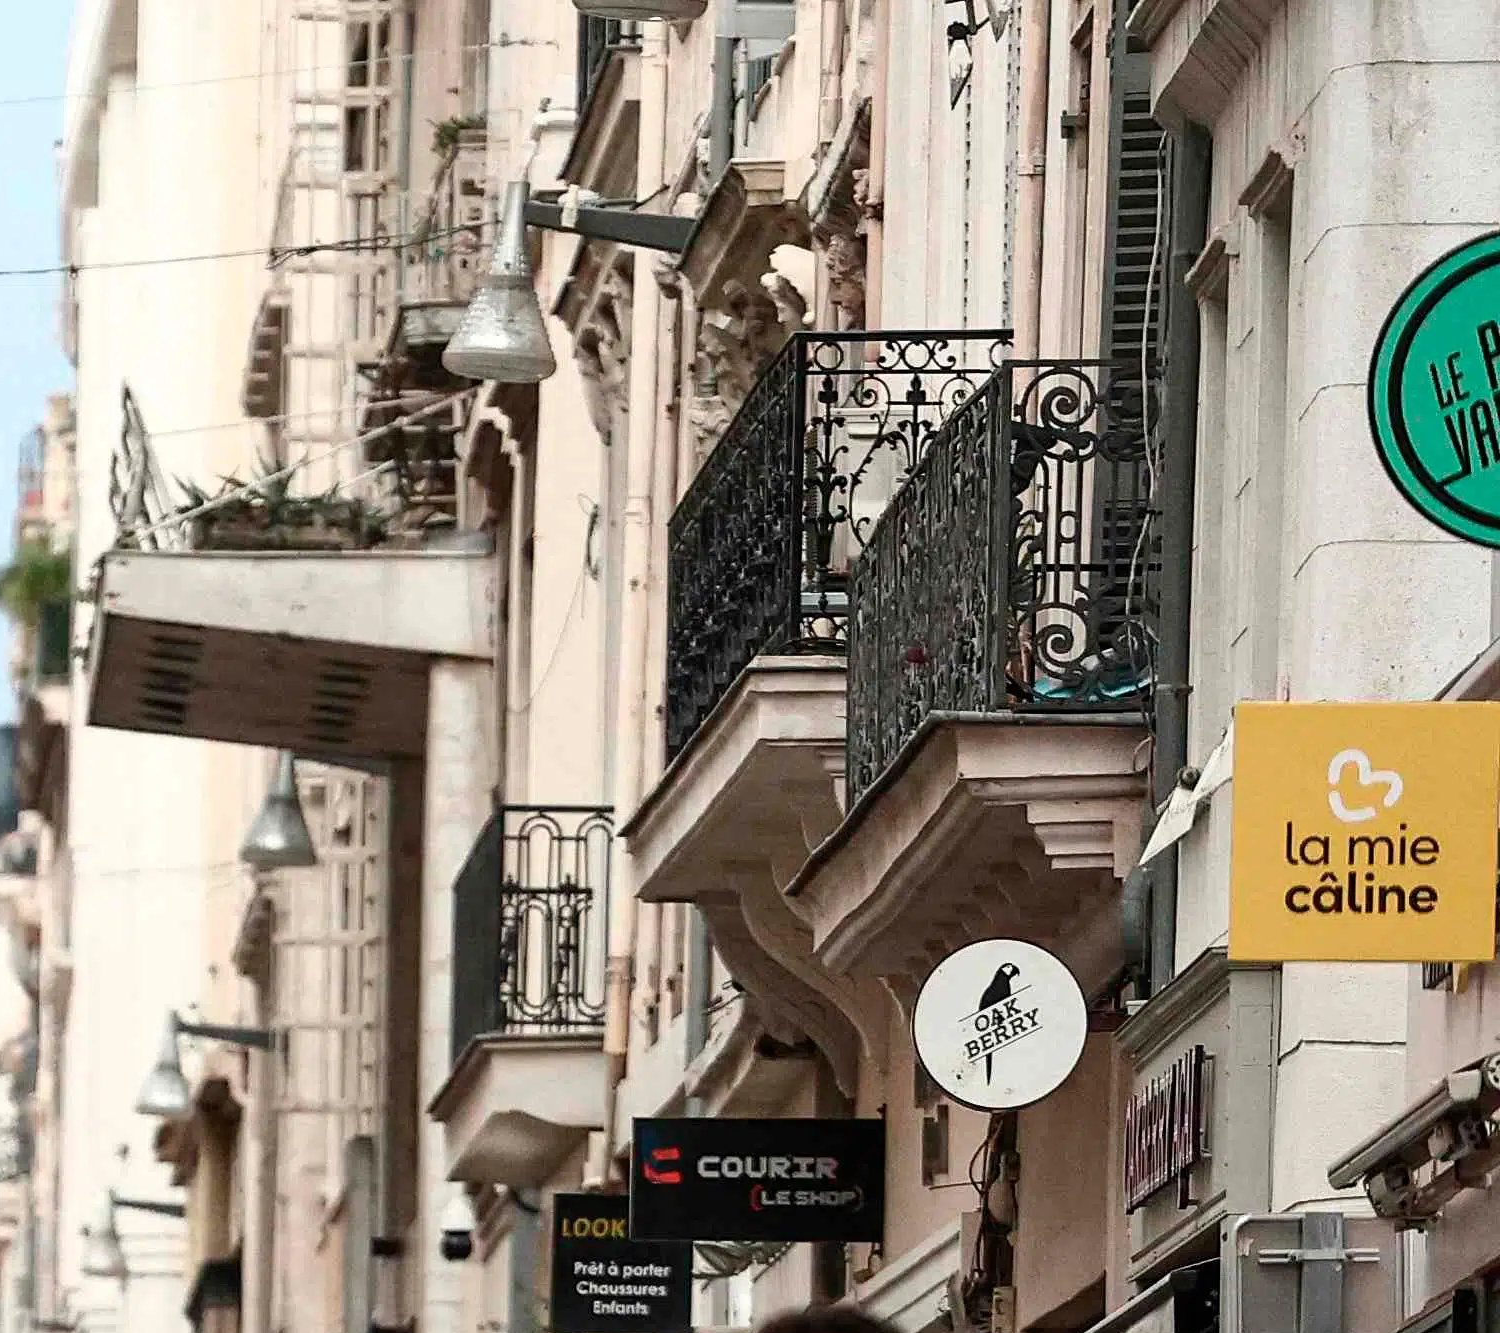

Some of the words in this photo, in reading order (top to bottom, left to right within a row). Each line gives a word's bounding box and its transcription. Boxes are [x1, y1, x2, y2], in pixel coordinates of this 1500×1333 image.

[1429, 350, 1471, 410] LE
[1286, 820, 1330, 866] la
[1348, 823, 1440, 866] mie
[1284, 870, 1439, 914] câline
[974, 997, 1022, 1032] OAK
[963, 1007, 1039, 1060] BERRY
[696, 1155, 840, 1180] COURIR
[561, 1217, 626, 1239] LOOK
[573, 1261, 605, 1276] Prêt
[607, 1260, 619, 1276] à
[622, 1263, 672, 1281] porter
[575, 1281, 668, 1297] Chaussures
[592, 1300, 649, 1316] Enfants
